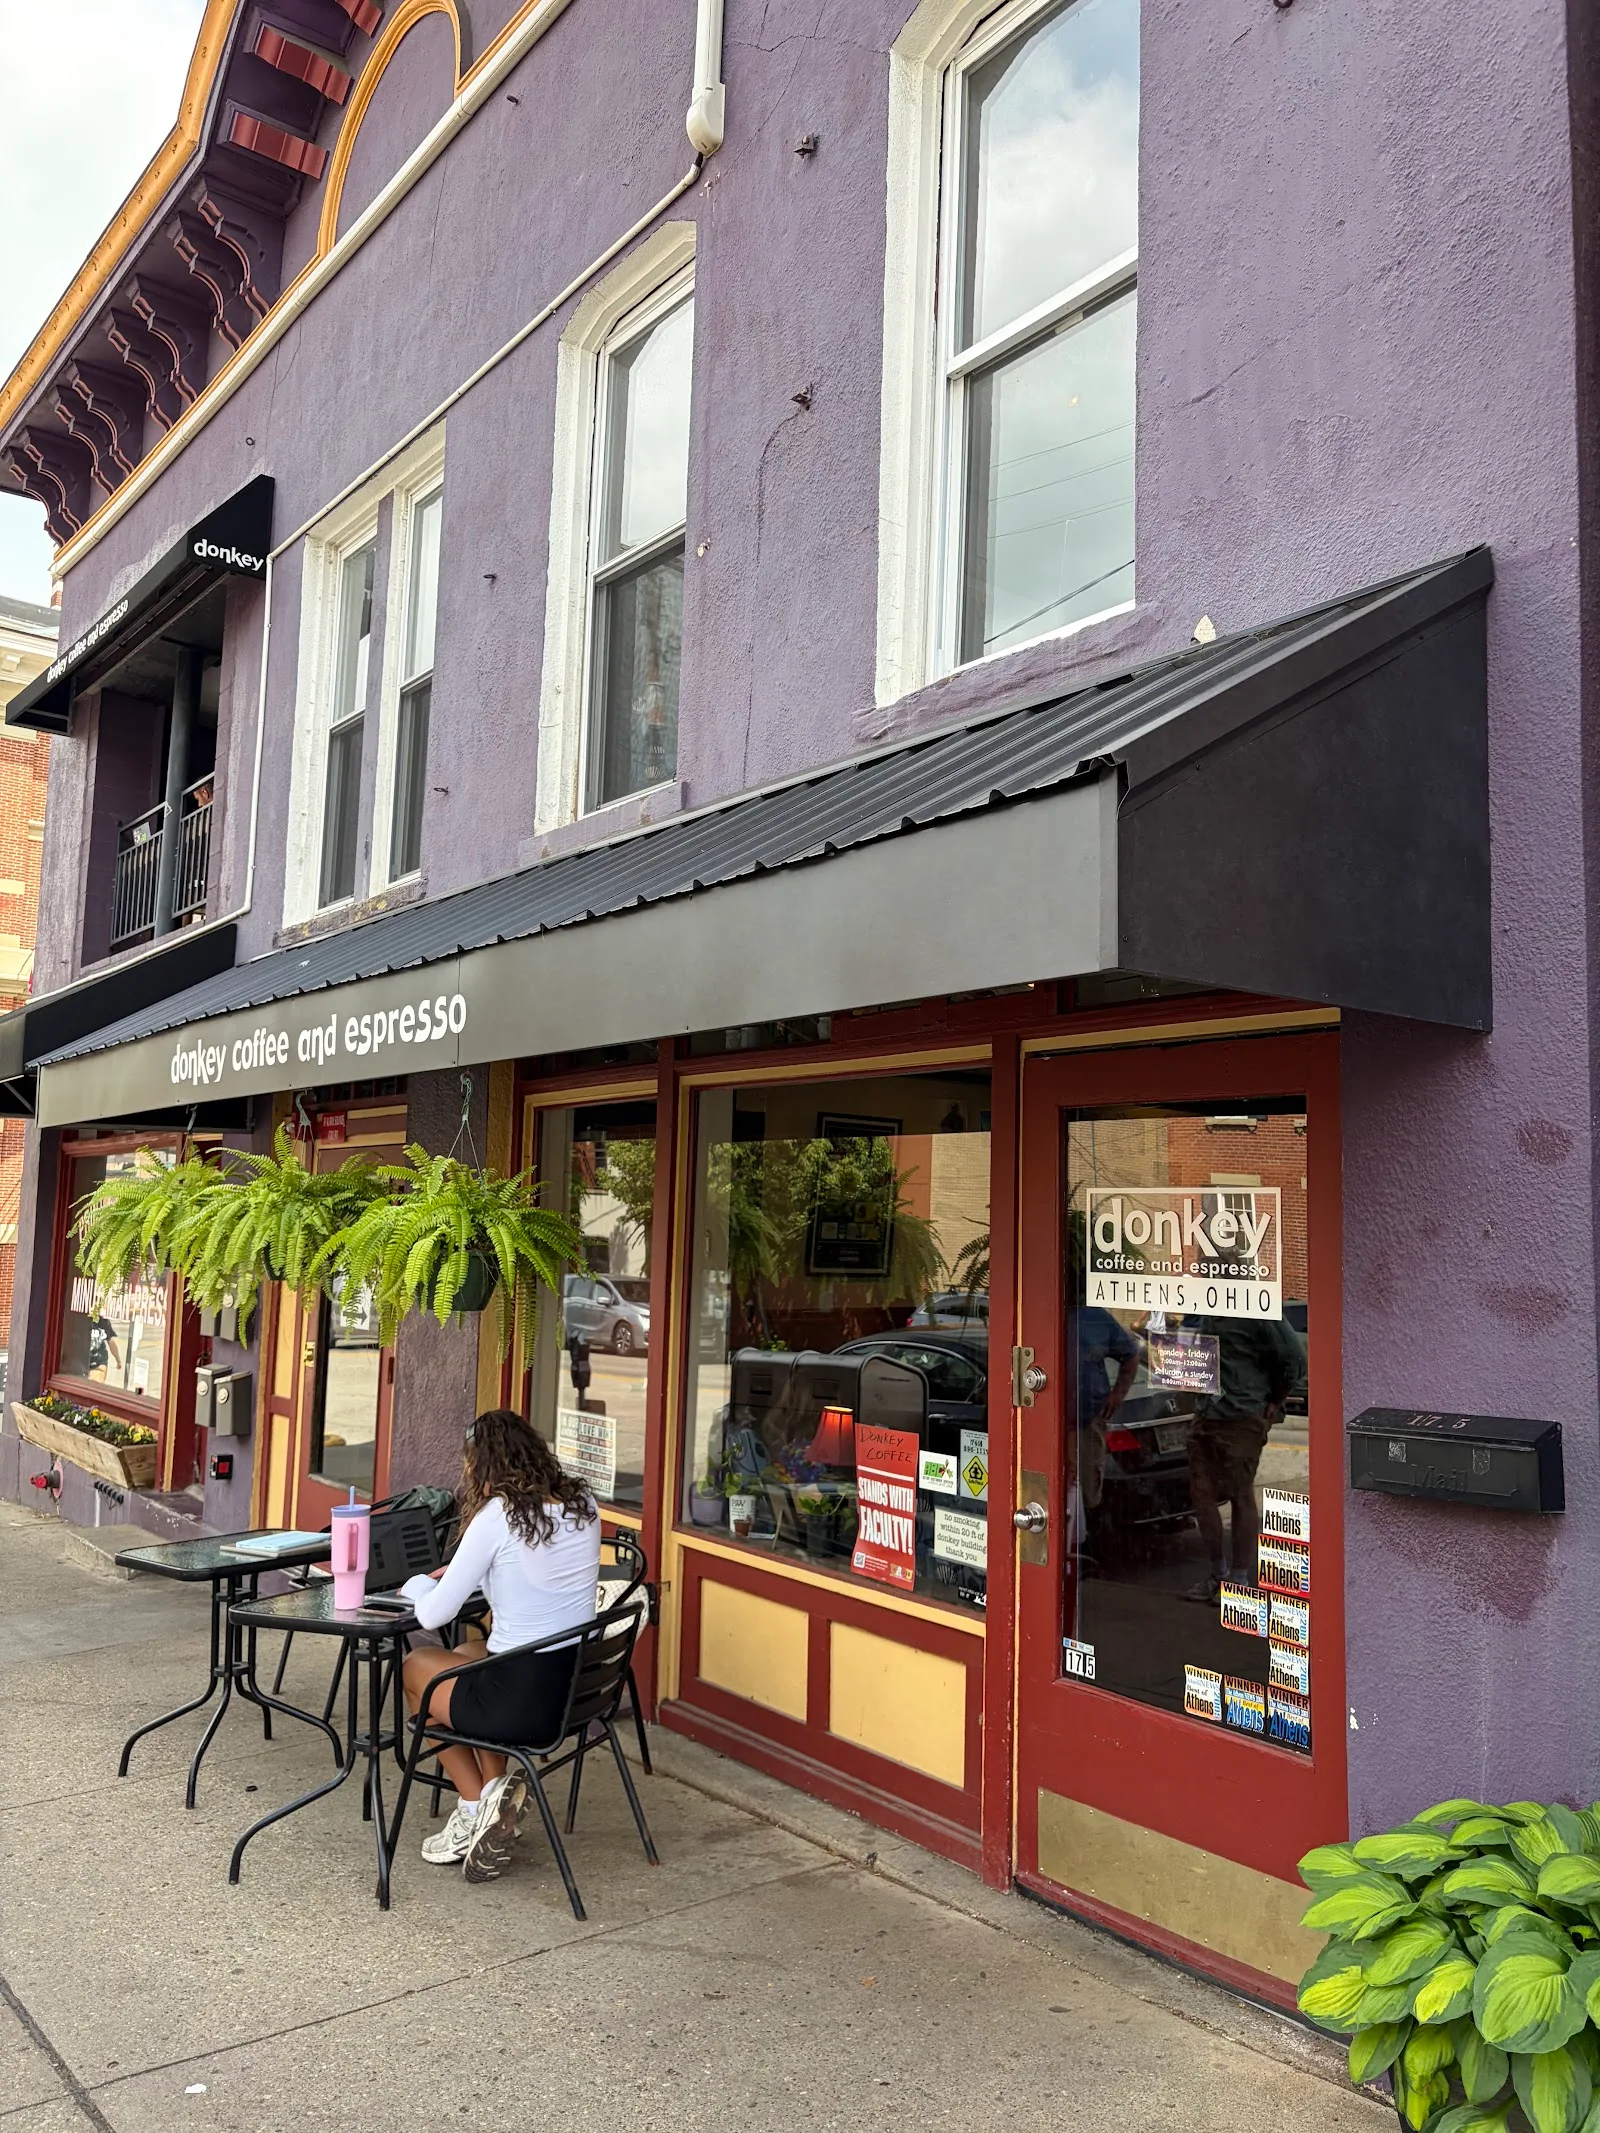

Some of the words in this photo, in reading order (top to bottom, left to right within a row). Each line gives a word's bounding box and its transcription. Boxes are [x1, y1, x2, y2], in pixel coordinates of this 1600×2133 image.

[193, 538, 265, 571] donkey
[47, 656, 67, 683] donkey
[68, 638, 87, 664] coffee
[87, 624, 98, 646] and
[99, 600, 128, 636] espresso
[170, 1039, 227, 1086] donkey
[232, 1027, 289, 1072] coffee
[298, 1013, 338, 1066] and
[344, 993, 467, 1056] espresso
[1094, 1198, 1272, 1259] donkey
[1096, 1254, 1145, 1271] coffee
[1150, 1257, 1183, 1273] and
[1189, 1262, 1270, 1279] espresso
[860, 1425, 904, 1447] DONKEY
[867, 1447, 914, 1464] COFFEE
[1409, 1463, 1468, 1491] Mail
[858, 1476, 888, 1507] STANDS
[889, 1484, 914, 1513] WITH
[1265, 1489, 1310, 1506] WINNER
[860, 1505, 913, 1556] FACULTY!
[940, 1523, 960, 1535] within
[961, 1527, 970, 1537] 20
[971, 1530, 977, 1539] ft
[977, 1532, 985, 1541] of
[944, 1513, 952, 1521] no
[953, 1516, 980, 1530] smoking
[1264, 1509, 1301, 1536] Athens
[937, 1532, 960, 1546] donkey
[961, 1539, 987, 1554] building
[945, 1546, 964, 1558] thank
[965, 1552, 977, 1561] you
[1259, 1535, 1309, 1557] WINNER
[1259, 1559, 1300, 1590] Athens
[1300, 1556, 1309, 1592] 2010
[1223, 1582, 1266, 1601] WINNER
[1271, 1592, 1307, 1611] WINNER
[1223, 1603, 1258, 1631] Athens
[1272, 1611, 1285, 1620] Best
[1270, 1619, 1300, 1641] Athens
[1270, 1640, 1307, 1659] WINNER
[1271, 1658, 1285, 1668] Best
[1186, 1666, 1220, 1683] WINNER
[1270, 1666, 1300, 1690] Athens
[1186, 1684, 1199, 1694] Best
[1270, 1688, 1309, 1710] WINNER
[1186, 1691, 1214, 1716] Athens
[1227, 1697, 1264, 1732] Athens
[1270, 1709, 1309, 1746] Athens
